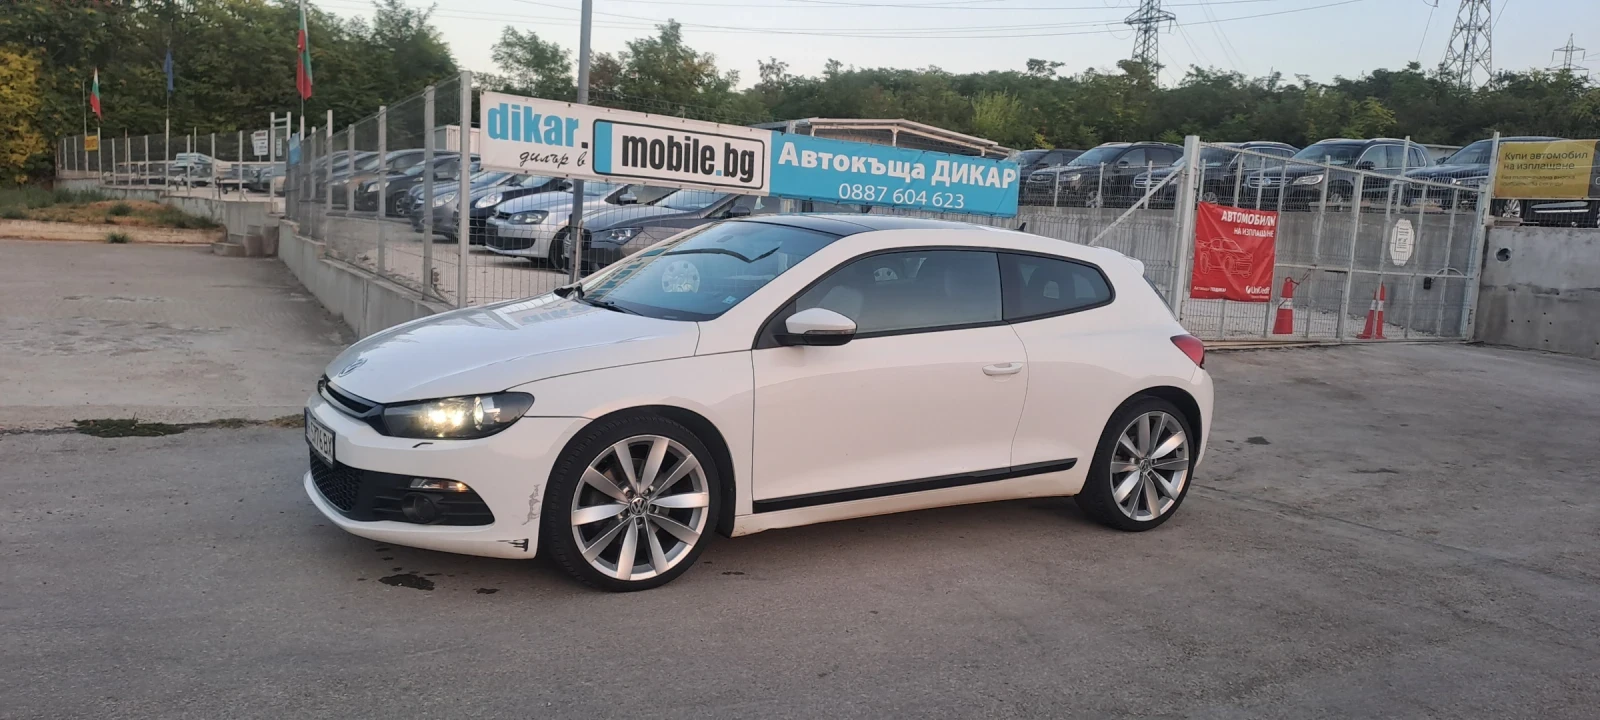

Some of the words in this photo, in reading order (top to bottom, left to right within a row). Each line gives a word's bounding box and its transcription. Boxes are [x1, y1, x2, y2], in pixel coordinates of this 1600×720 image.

[519, 149, 570, 168] дилър
[576, 150, 586, 167] в
[621, 133, 755, 183] mobile.bg
[778, 141, 926, 183] Автокъща
[931, 159, 1017, 189] ДИКАР
[1504, 152, 1528, 161] Купи
[1530, 150, 1588, 160] автомобил
[1503, 162, 1515, 170] на
[1517, 161, 1575, 171] изплащане
[838, 183, 888, 202] 0887
[892, 187, 928, 206] 604
[932, 191, 965, 209] 623
[1221, 210, 1276, 226] АВТОМОБИЛИ
